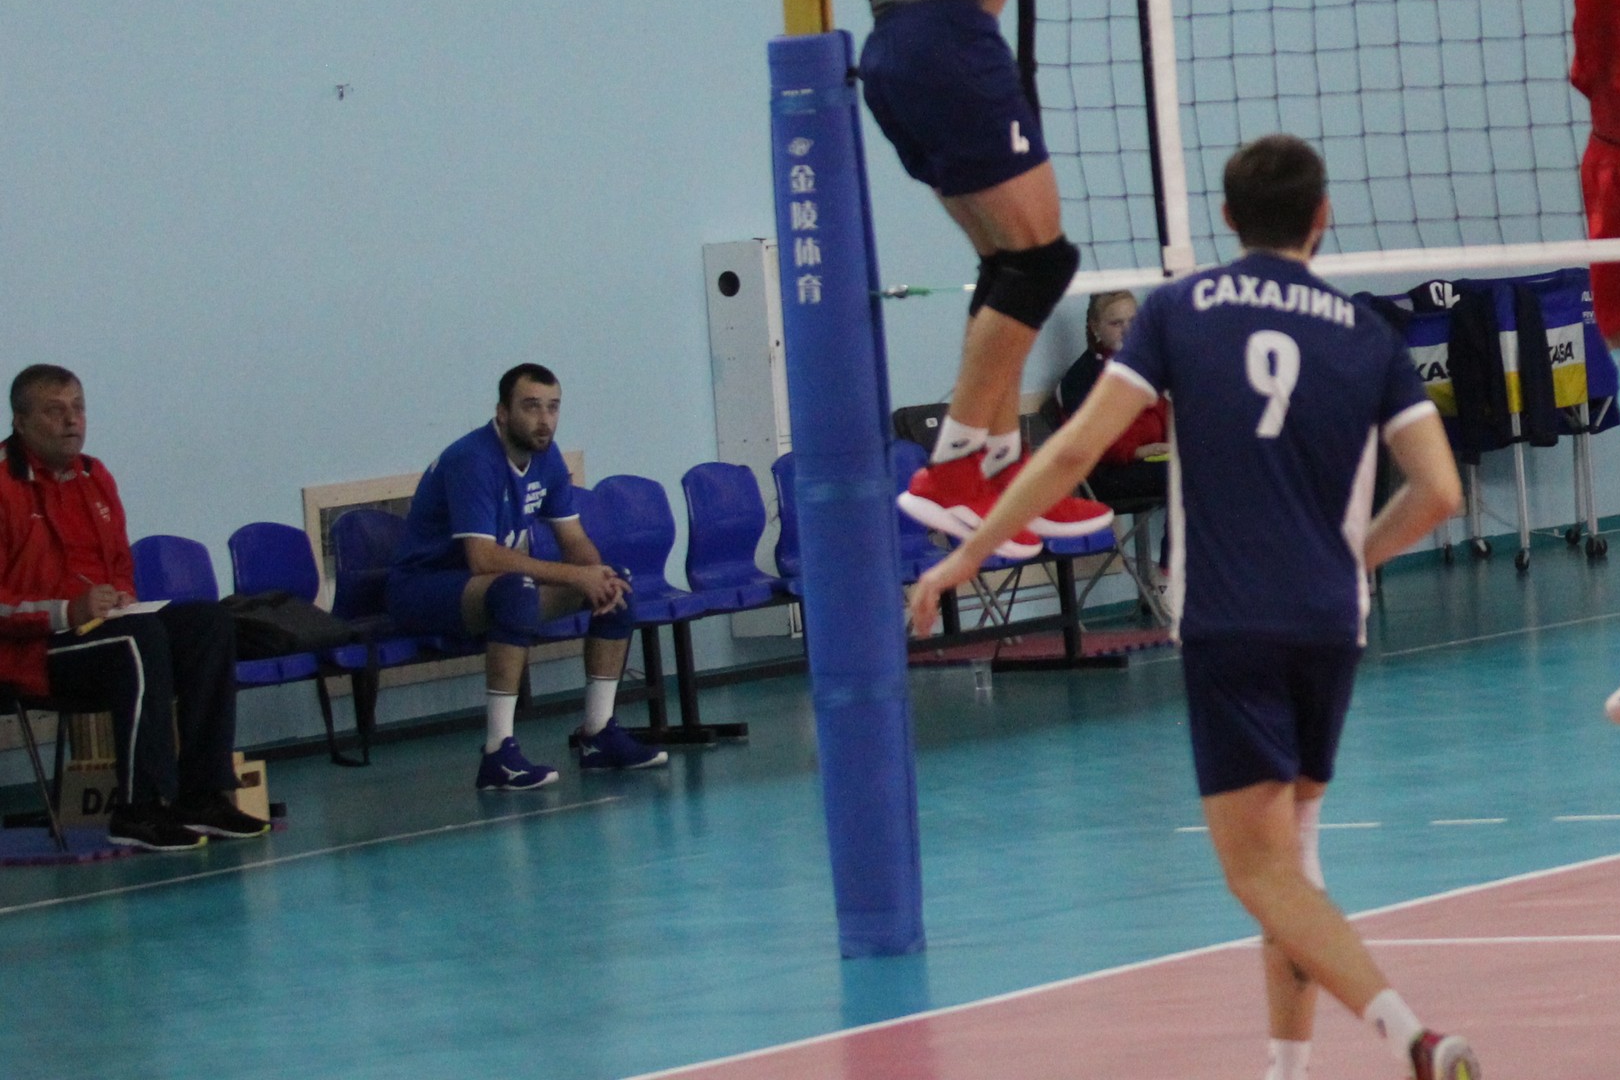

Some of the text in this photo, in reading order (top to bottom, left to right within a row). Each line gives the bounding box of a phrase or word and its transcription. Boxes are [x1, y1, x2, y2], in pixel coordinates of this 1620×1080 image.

[790, 164, 823, 305] 金陵体育
[1193, 274, 1355, 329] САХАЛИН
[1245, 330, 1300, 438] 9
